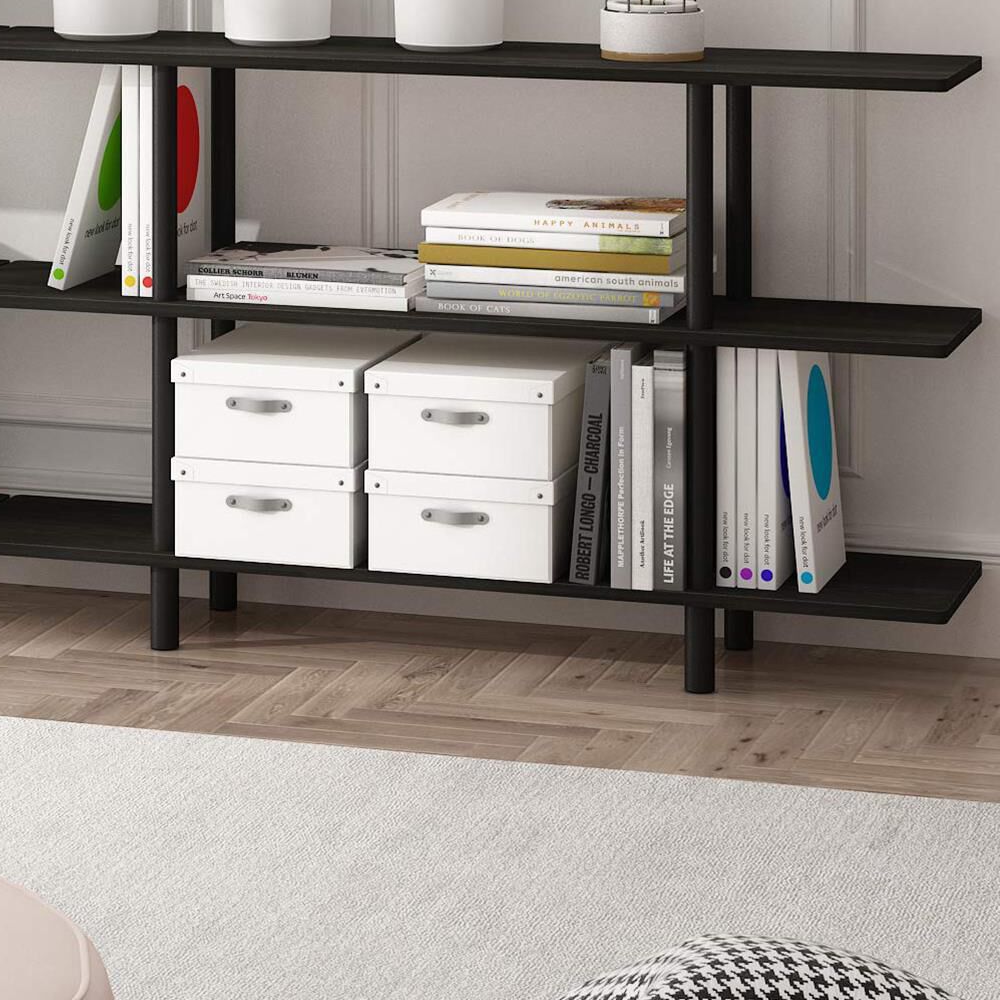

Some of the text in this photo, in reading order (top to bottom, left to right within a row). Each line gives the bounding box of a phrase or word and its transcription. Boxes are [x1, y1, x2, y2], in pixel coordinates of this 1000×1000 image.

[534, 219, 640, 230] HAPPY ANIMALS
[458, 234, 486, 242] BOOK
[506, 236, 535, 244] DOGS
[198, 267, 230, 275] COLLIER
[232, 269, 264, 277] SCHORR
[554, 276, 679, 288] american south animals
[226, 292, 246, 300] Space
[247, 294, 268, 302] Tokyo
[438, 302, 511, 313] BOOK OF CATS
[584, 412, 603, 474] CHARCOAL
[617, 426, 625, 448] Form
[617, 458, 625, 500] Perfection
[664, 483, 674, 515] EDGE
[579, 494, 596, 532] LONGO
[617, 502, 625, 568] MAPPLETHORPE
[664, 516, 674, 540] THE
[575, 534, 592, 580] ROBERT
[664, 542, 674, 558] AT
[664, 560, 674, 583] LIFE
